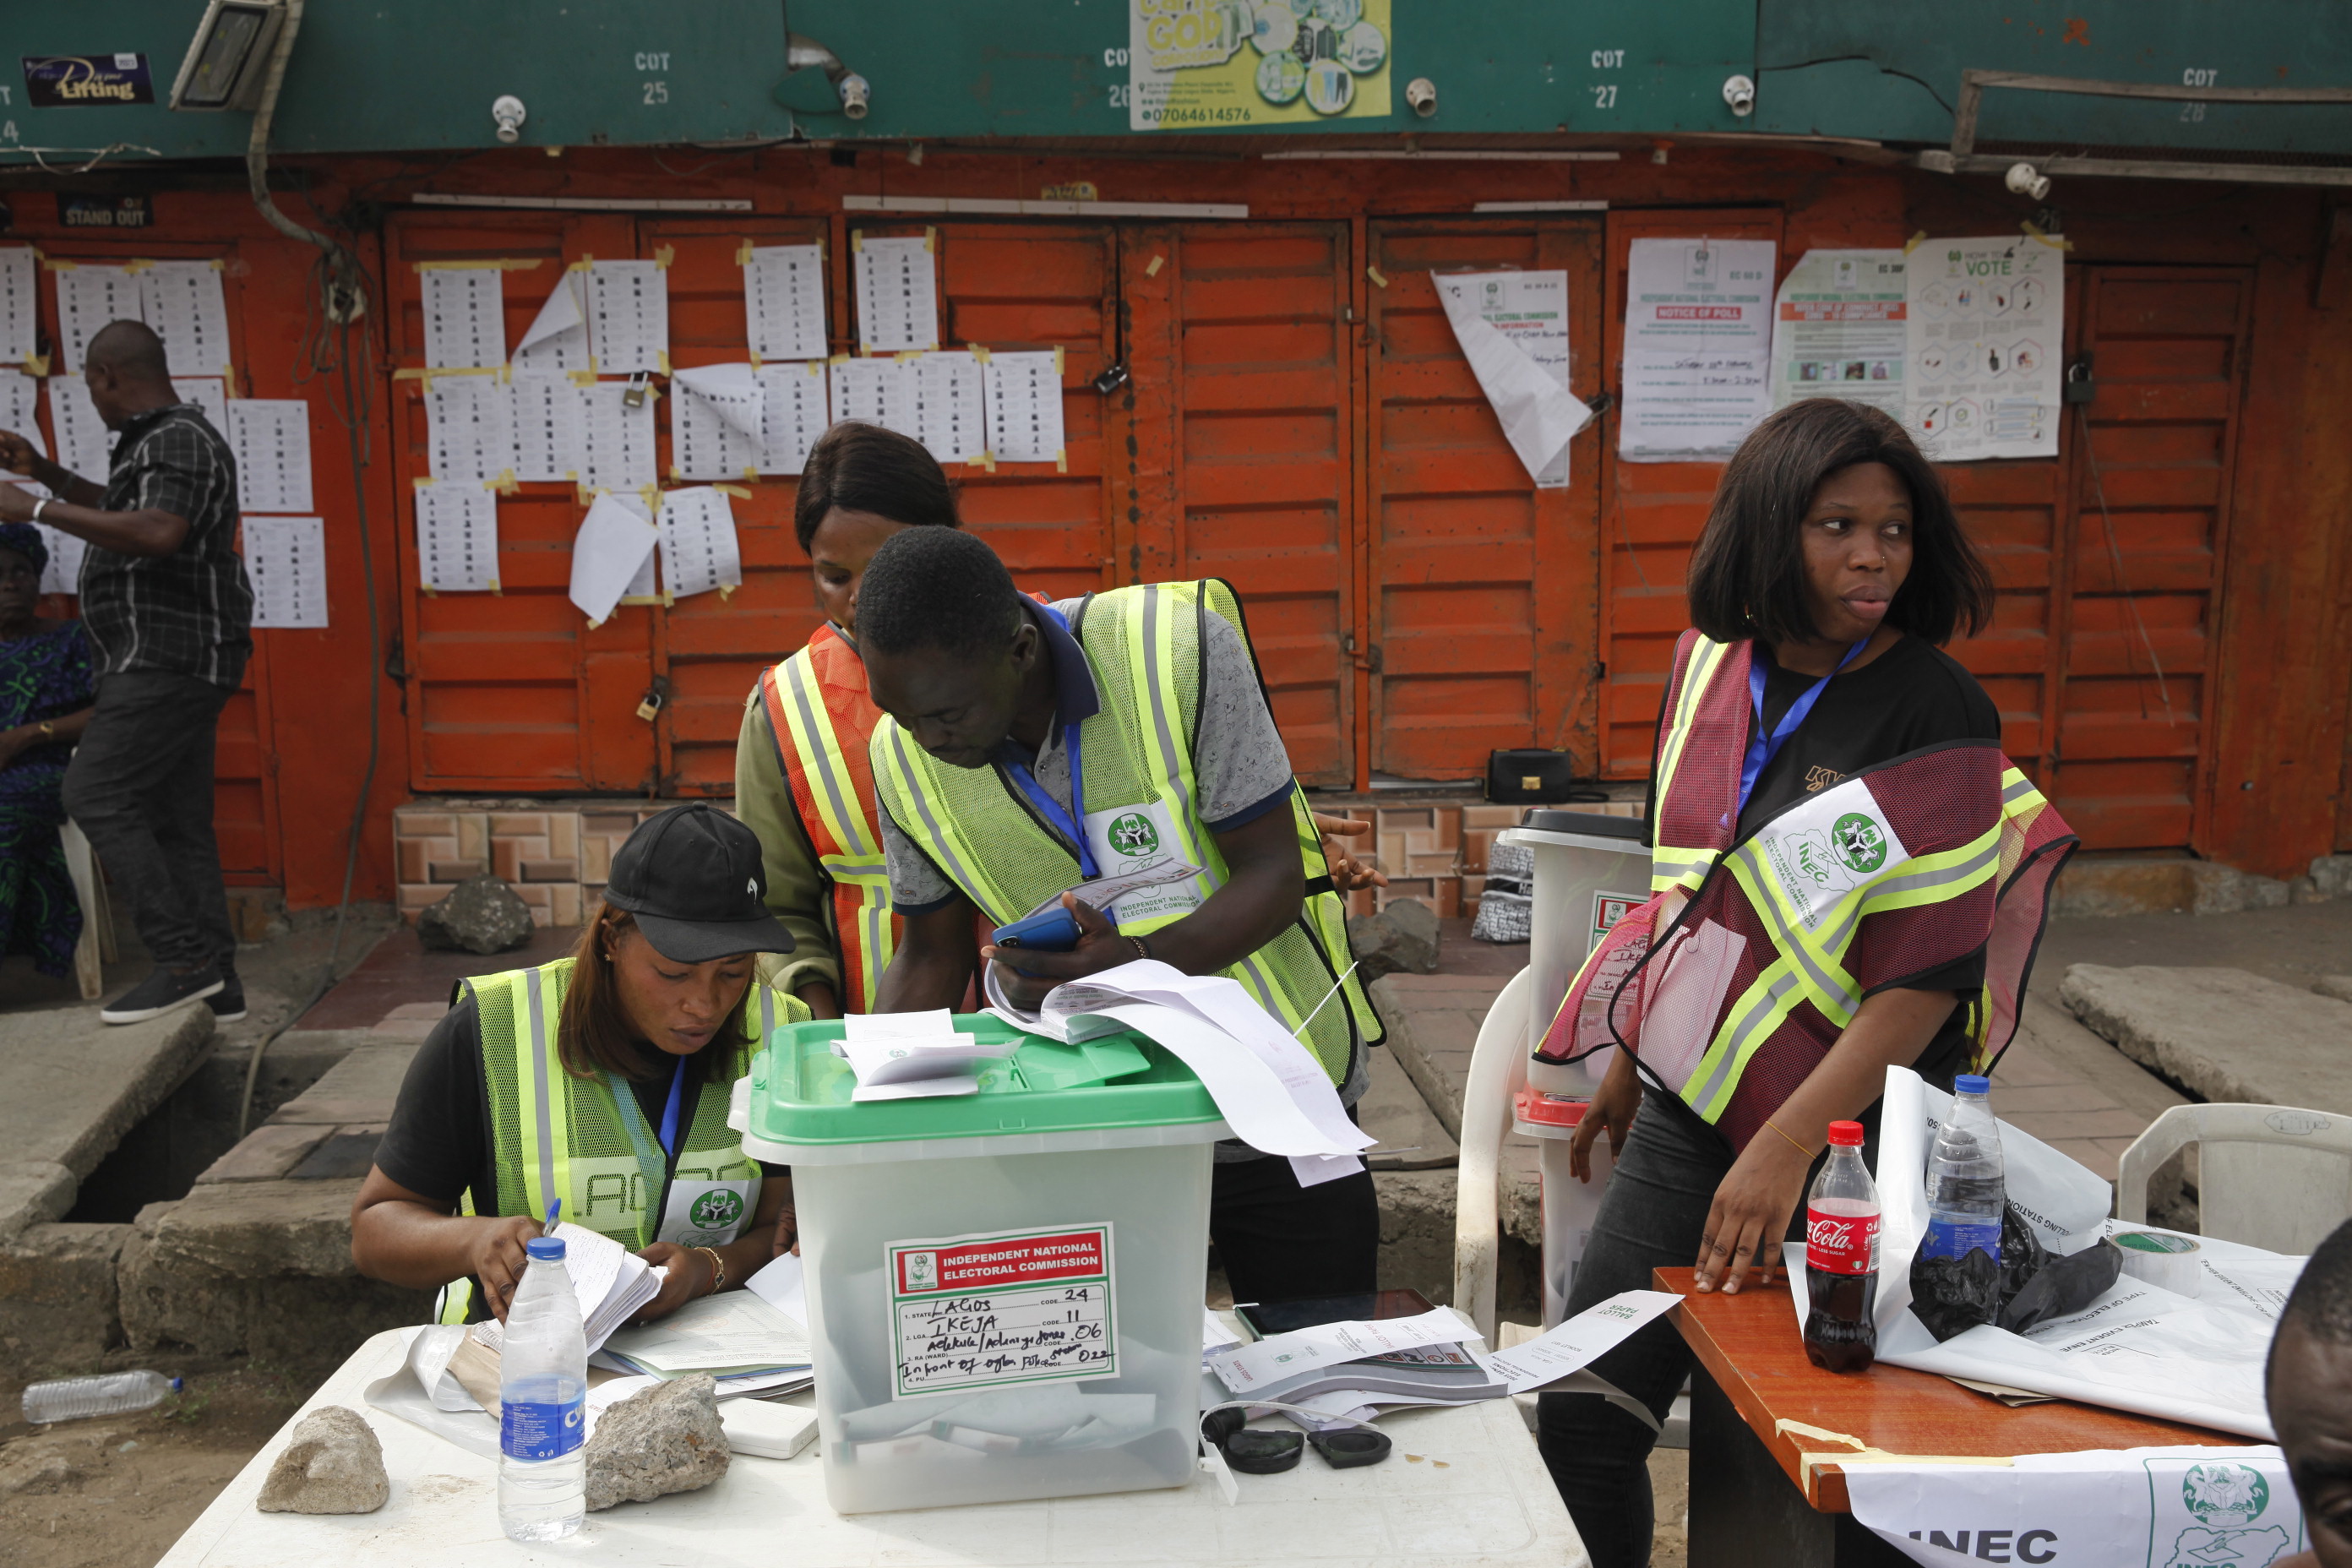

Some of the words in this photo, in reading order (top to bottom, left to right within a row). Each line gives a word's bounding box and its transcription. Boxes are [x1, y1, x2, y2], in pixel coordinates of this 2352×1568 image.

[1146, 8, 1222, 50] GOD
[634, 52, 670, 71] COT
[1104, 48, 1130, 67] CO
[1591, 50, 1625, 68] COT
[2183, 68, 2219, 88] COT
[643, 81, 667, 105] 25
[1595, 85, 1618, 108] 27
[66, 210, 113, 226] STAND
[117, 210, 144, 226] OUT
[1965, 260, 2012, 276] VOTE
[1658, 308, 1695, 318] NOTICE
[1699, 308, 1711, 318] OF
[1713, 308, 1740, 319] POLL
[1799, 842, 1829, 883] INEC
[1764, 839, 1788, 883] ELECTORAL
[1786, 884, 1816, 928] COMMISSION
[1769, 836, 1799, 885] INDEPENDENT
[1796, 888, 1818, 923] NATIONAL
[1120, 897, 1167, 912] INDEPENDENT
[1122, 906, 1163, 918] ELECTORAL
[1163, 899, 1200, 910] COMMISSION
[943, 1248, 1030, 1267] INDEPENDENT
[1033, 1242, 1096, 1257] NATIONAL
[944, 1263, 1016, 1281] ELECTORAL
[1019, 1255, 1099, 1273] COMMISSION
[1065, 1288, 1088, 1302] 24
[2110, 1299, 2124, 1308] OF
[2123, 1291, 2148, 1302] TYPE
[932, 1298, 991, 1318] LAGOS
[1067, 1309, 1079, 1323] 11
[1597, 1309, 1634, 1320] BALLOT
[1609, 1304, 1640, 1314] PAPER
[927, 1315, 999, 1338] IKEJA
[2121, 1318, 2160, 1329] TAMPER
[2086, 1327, 2123, 1343] EVIDENT
[1233, 1360, 1243, 1370] STATE
[1242, 1369, 1253, 1382] LAGOS
[1909, 1529, 2058, 1564] NEC
